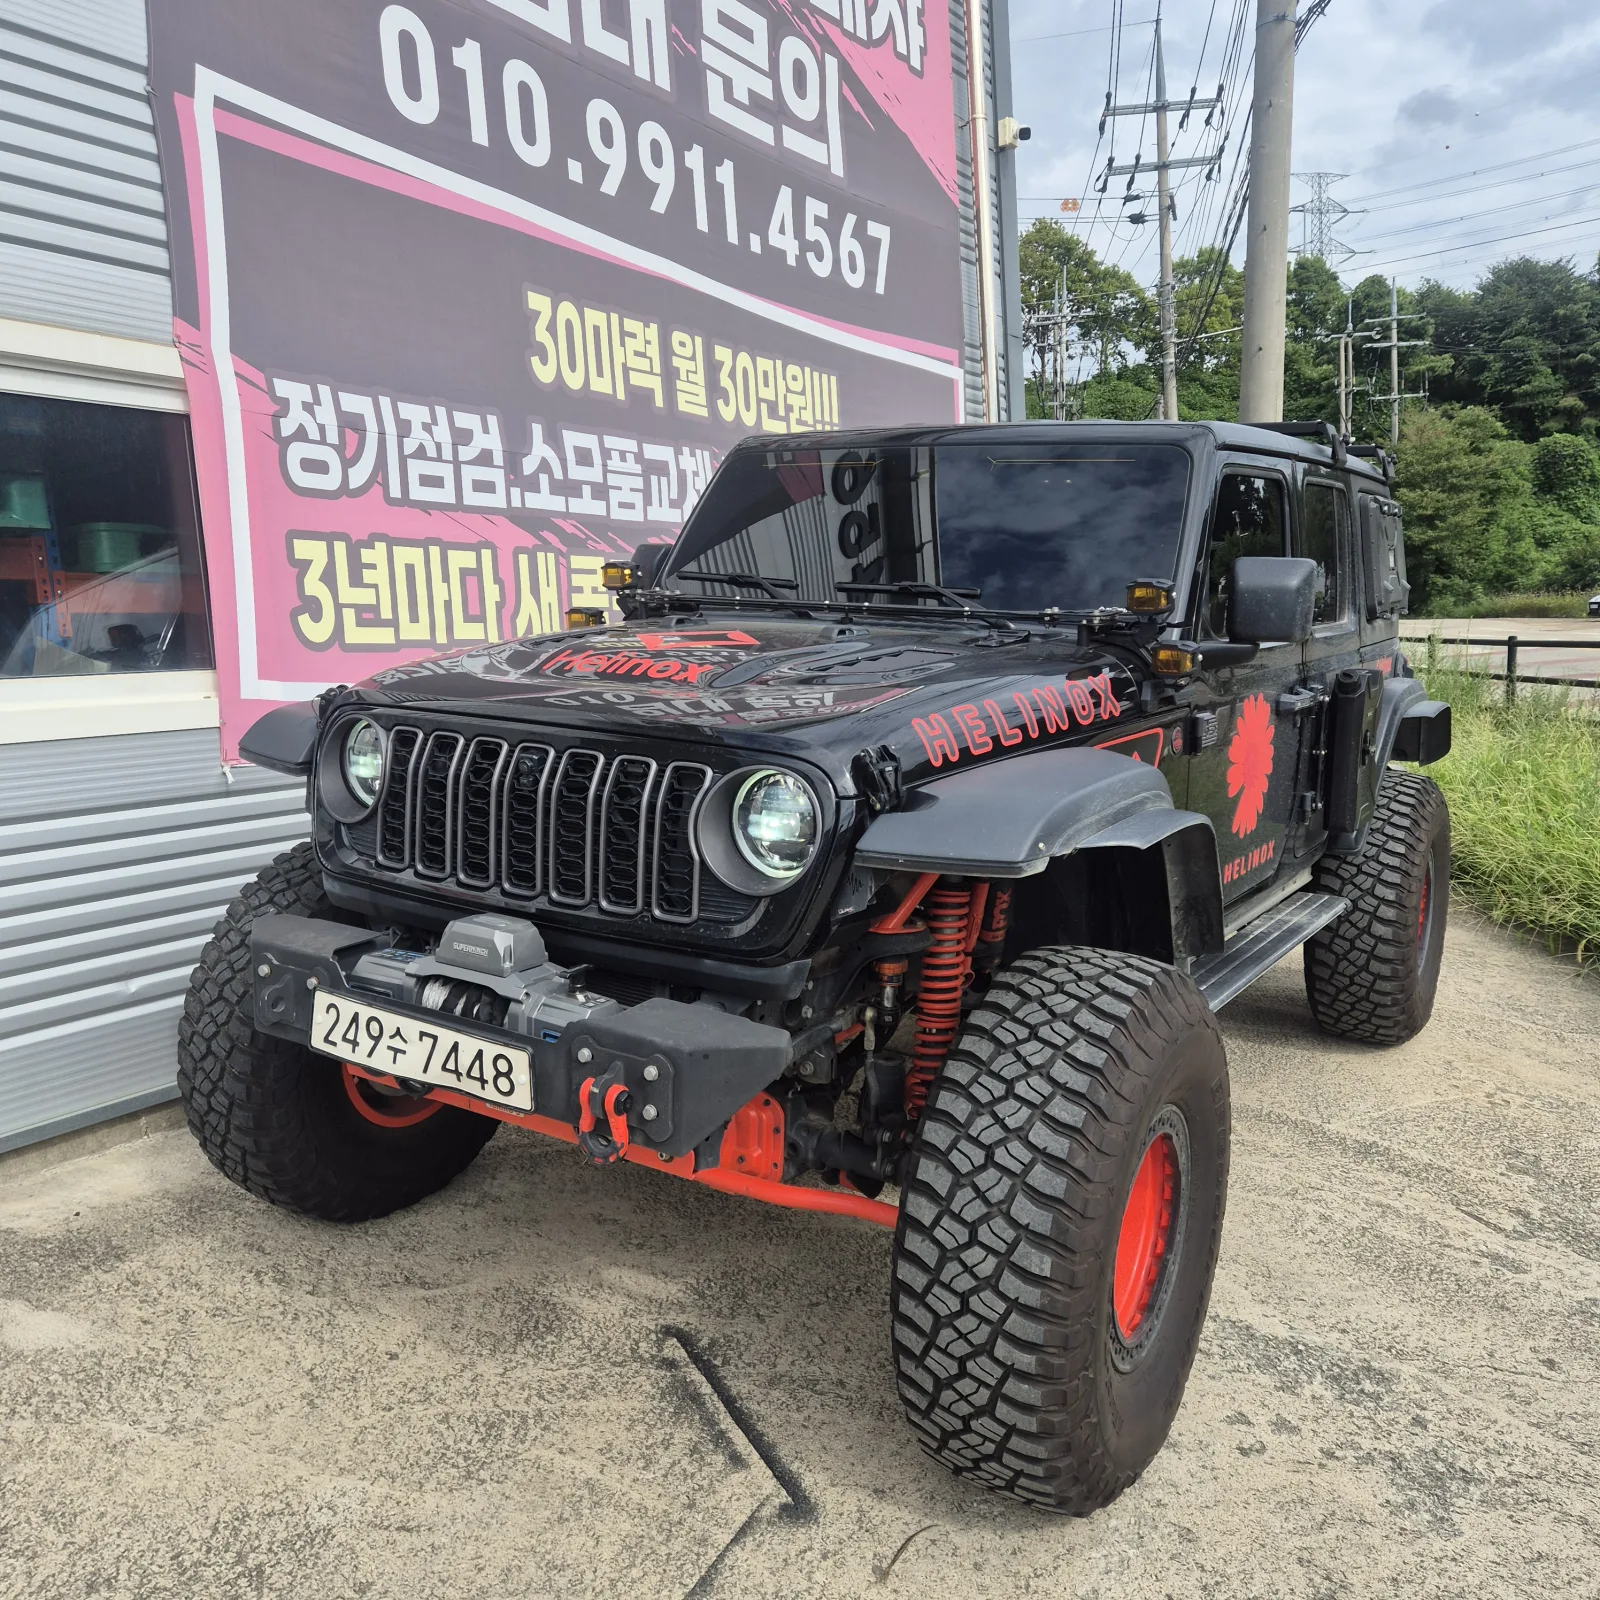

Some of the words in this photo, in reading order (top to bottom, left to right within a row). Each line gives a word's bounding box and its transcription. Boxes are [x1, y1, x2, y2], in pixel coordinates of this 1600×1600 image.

[702, 0, 843, 178] 문의
[378, 4, 892, 295] 010.9911.4567
[527, 290, 664, 408] 30마력
[671, 330, 708, 417] 월
[713, 344, 840, 434] 30만원!!!
[293, 538, 500, 644] 3년마다
[514, 551, 561, 638] 새
[542, 649, 714, 684] Helinox
[911, 674, 1121, 768] HELINOX
[1223, 839, 1275, 885] HELINOX
